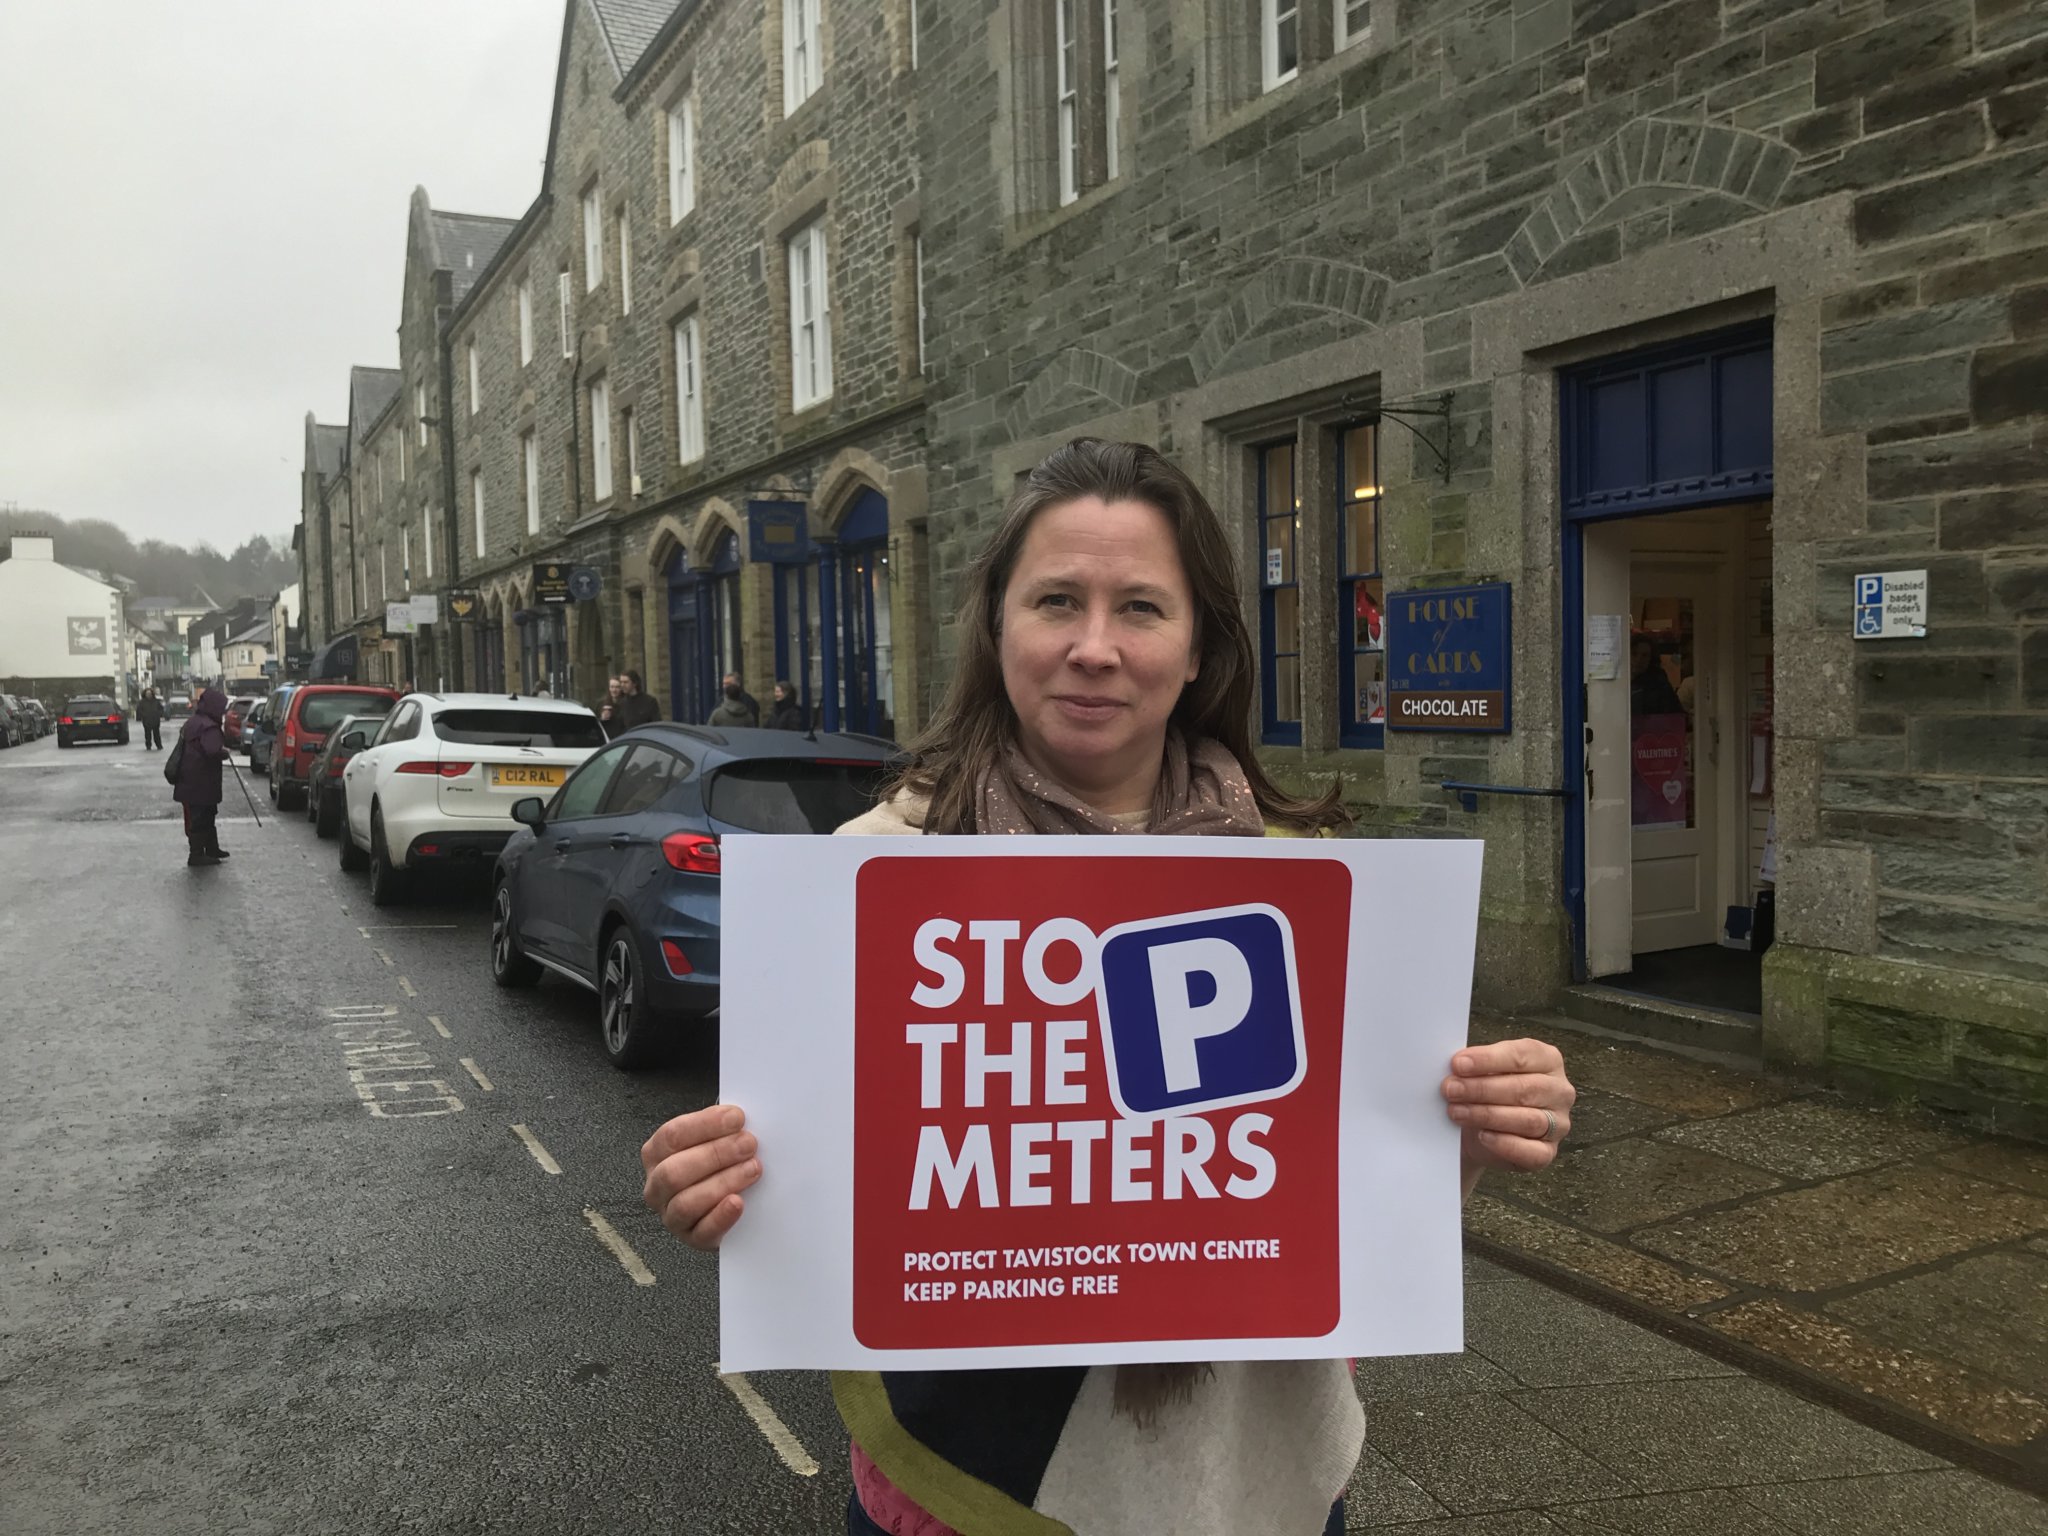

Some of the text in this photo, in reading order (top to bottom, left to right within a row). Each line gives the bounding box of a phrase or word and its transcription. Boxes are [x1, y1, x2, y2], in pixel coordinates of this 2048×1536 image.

[1862, 579, 1879, 604] P
[1884, 581, 1925, 592] Disabled
[1889, 593, 1918, 603] badge
[1408, 596, 1480, 623] HOUSE
[1893, 615, 1913, 625] only
[1432, 619, 1454, 653] of
[1407, 650, 1483, 675] CARDS
[1402, 698, 1488, 716] CHOCOLATE
[1637, 747, 1679, 760] VALENTINE'S
[505, 769, 554, 783] C12 RAL
[905, 1020, 1088, 1109] THE
[908, 1112, 1277, 1211] METERS
[904, 1238, 1280, 1272] PROTECT TAVISTOCK TOWN CENTRE
[904, 1274, 1119, 1302] KEEP PARKING FREE
